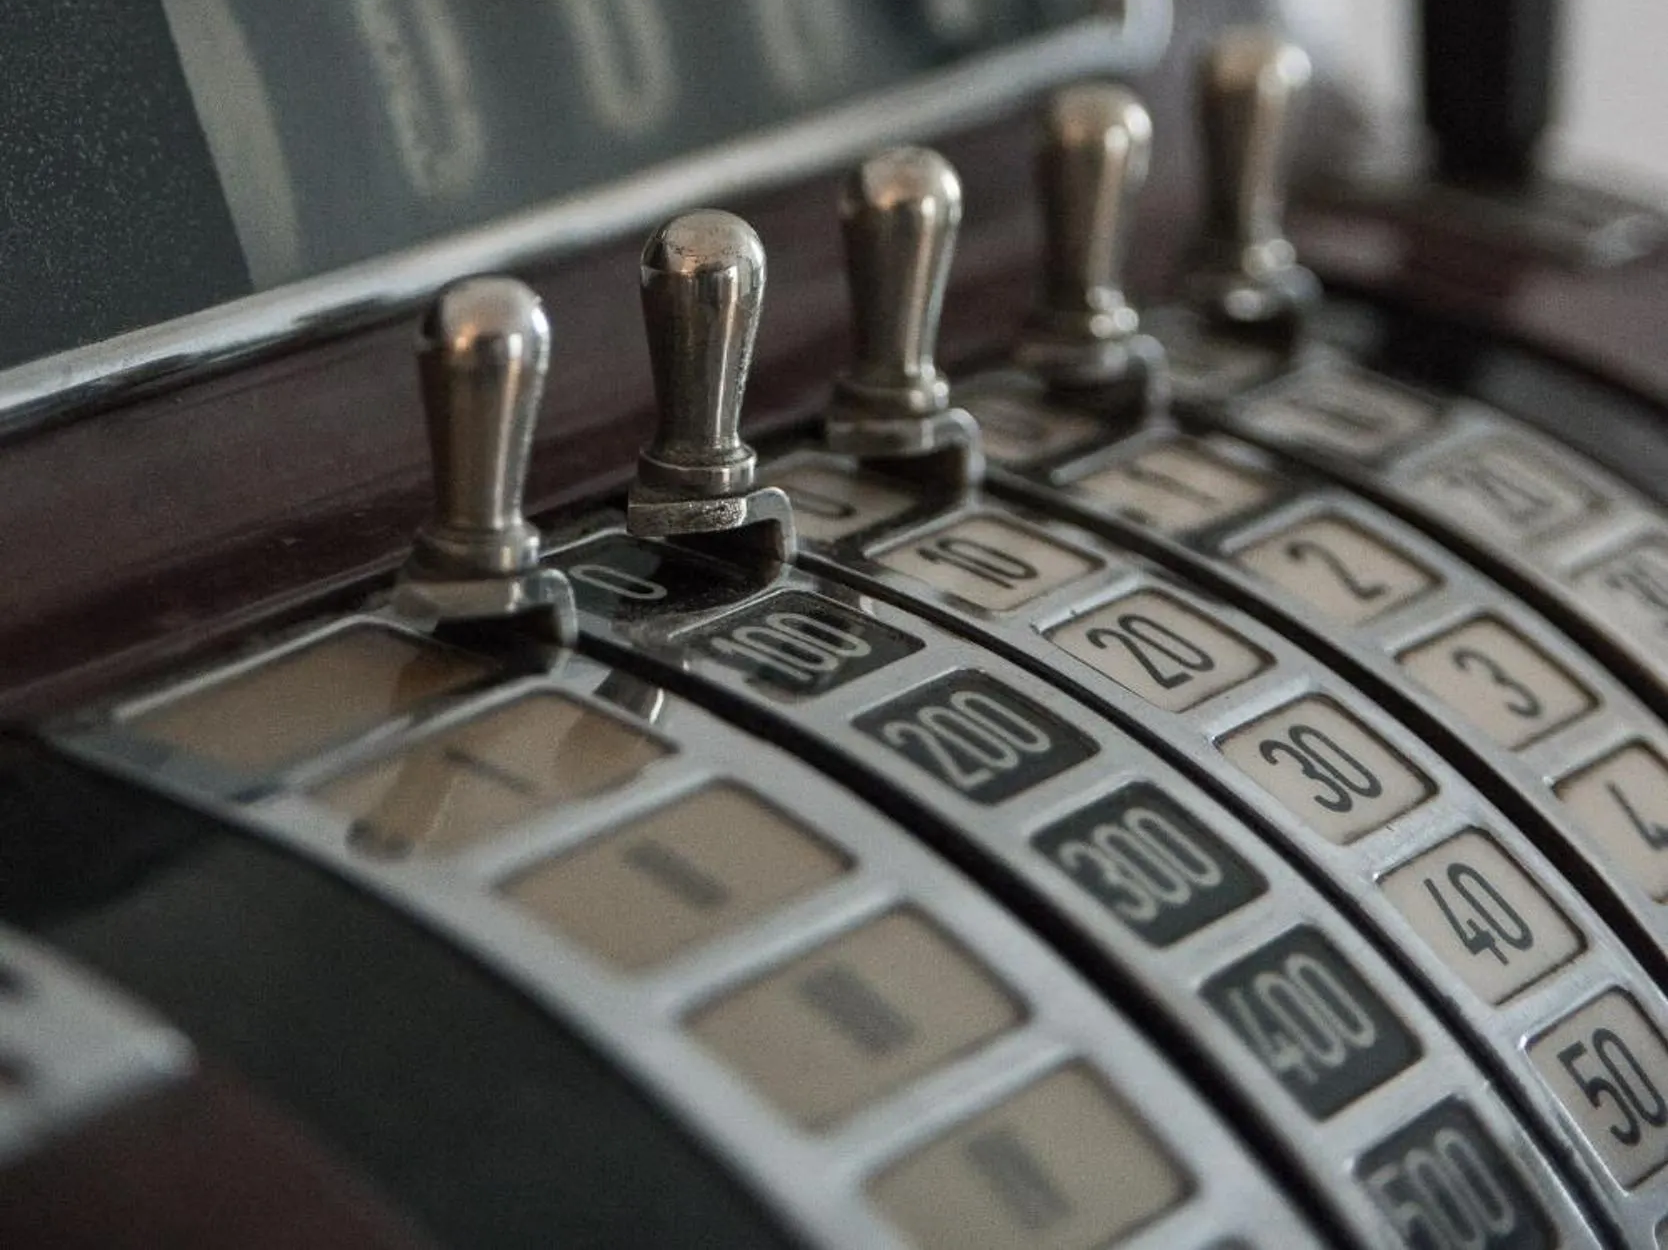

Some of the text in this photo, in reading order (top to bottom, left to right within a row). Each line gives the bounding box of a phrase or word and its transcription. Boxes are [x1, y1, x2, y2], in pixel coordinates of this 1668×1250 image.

[570, 564, 668, 600] 0
[917, 538, 1038, 590] 10
[1286, 541, 1387, 600] 2
[709, 611, 872, 683] 100
[1086, 613, 1215, 690] 20
[1451, 648, 1543, 718] 3
[883, 690, 1051, 791] 200
[1258, 723, 1383, 813] 30
[1058, 806, 1223, 922] 300
[1422, 861, 1535, 967] 40
[1226, 951, 1377, 1086] 400
[1557, 1026, 1668, 1147] 50
